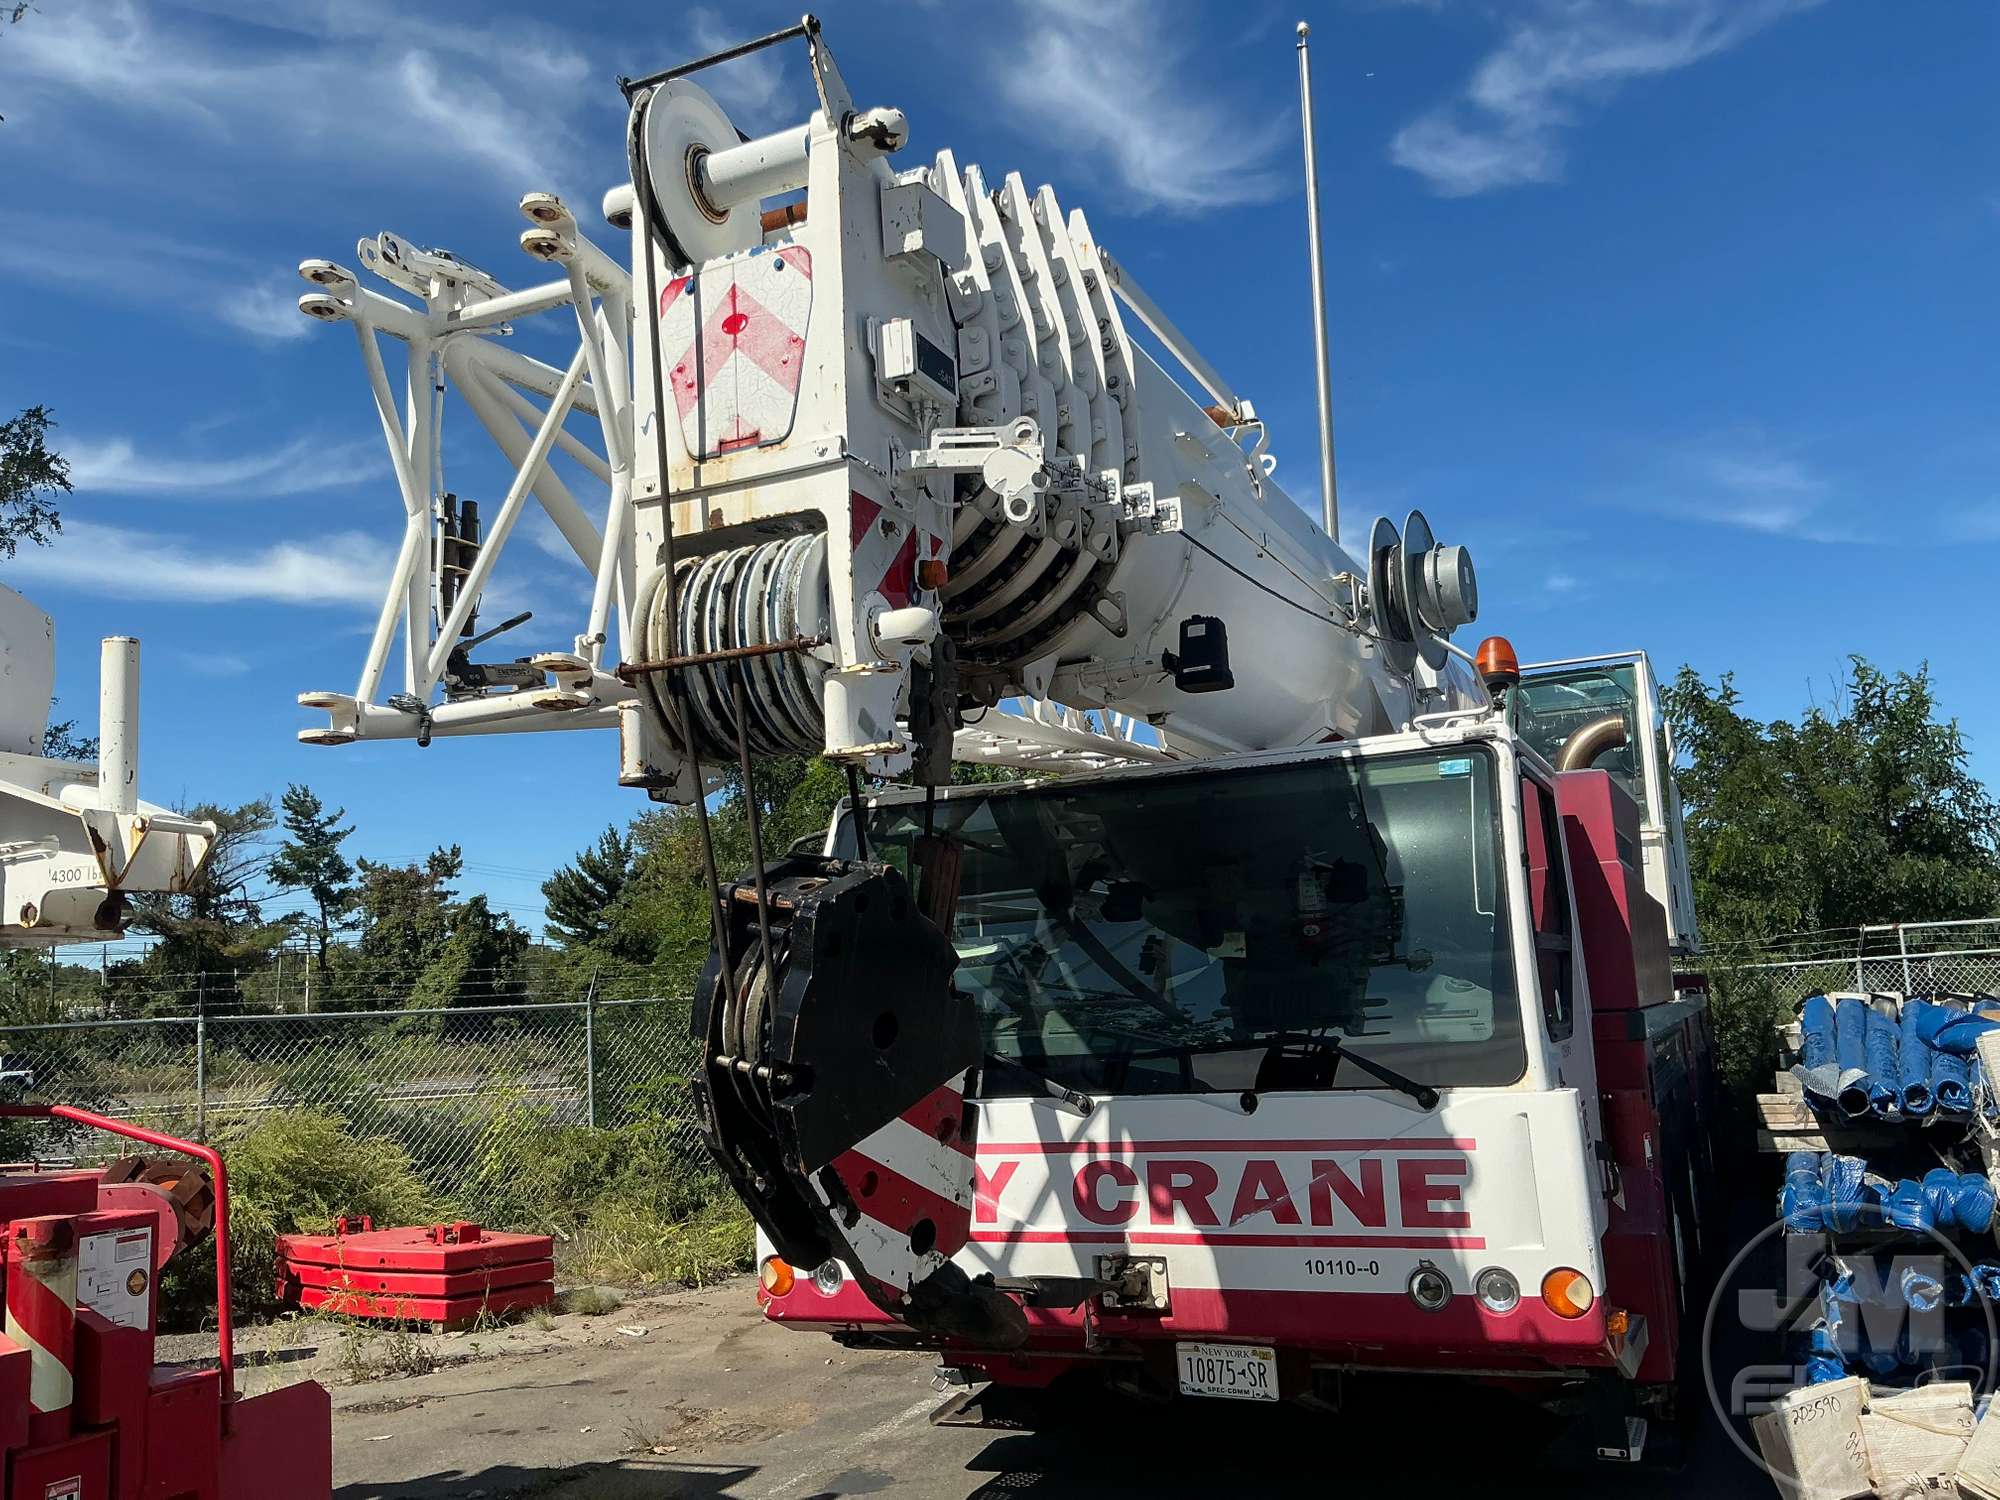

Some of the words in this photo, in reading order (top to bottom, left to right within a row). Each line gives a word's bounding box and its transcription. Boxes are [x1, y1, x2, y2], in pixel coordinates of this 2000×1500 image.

[974, 1160, 1020, 1224] Y
[1072, 1158, 1471, 1229] CRANE
[1201, 1347, 1223, 1356] NEW
[1223, 1349, 1250, 1358] YORK
